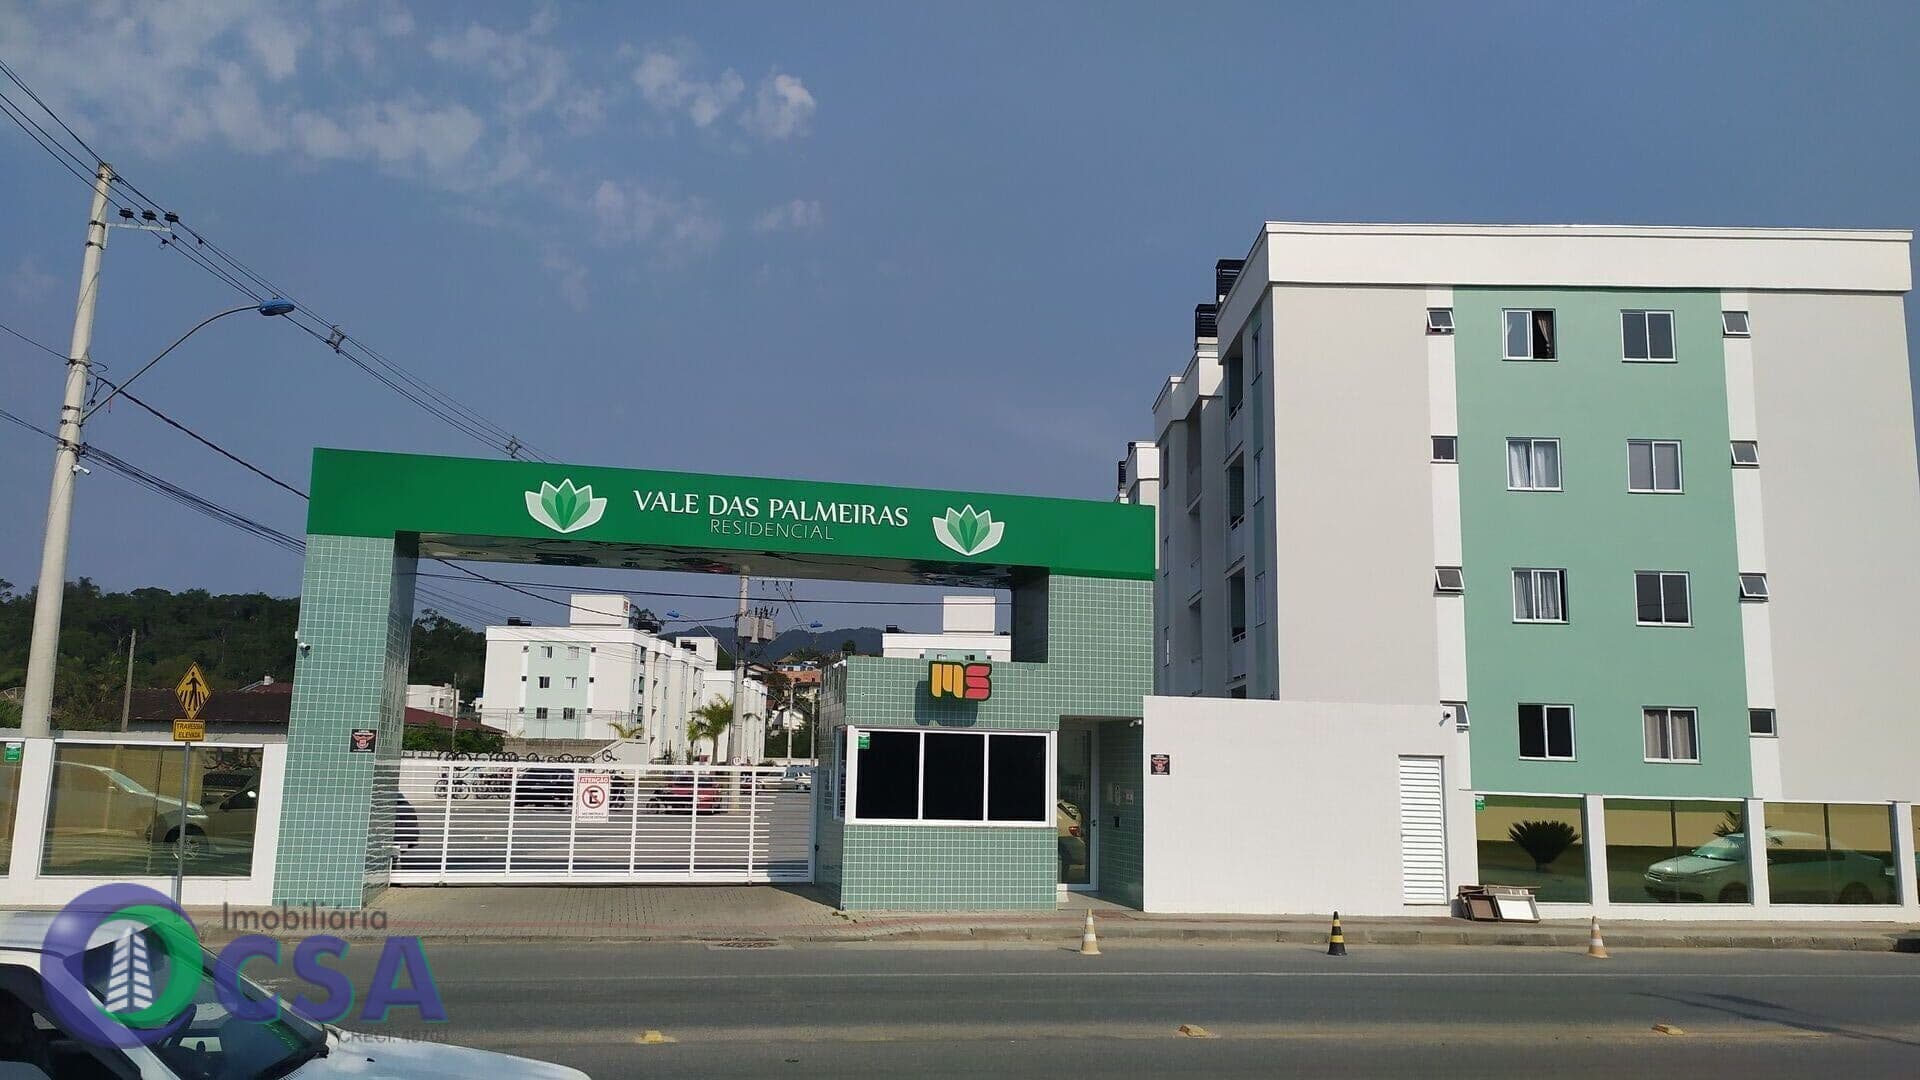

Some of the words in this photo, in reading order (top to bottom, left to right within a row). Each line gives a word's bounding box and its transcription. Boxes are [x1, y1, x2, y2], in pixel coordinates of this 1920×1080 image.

[633, 489, 700, 515] VALE
[708, 494, 760, 518] DAS
[768, 498, 909, 528] PALMEIRAS
[710, 518, 834, 540] RESIDENCIAL
